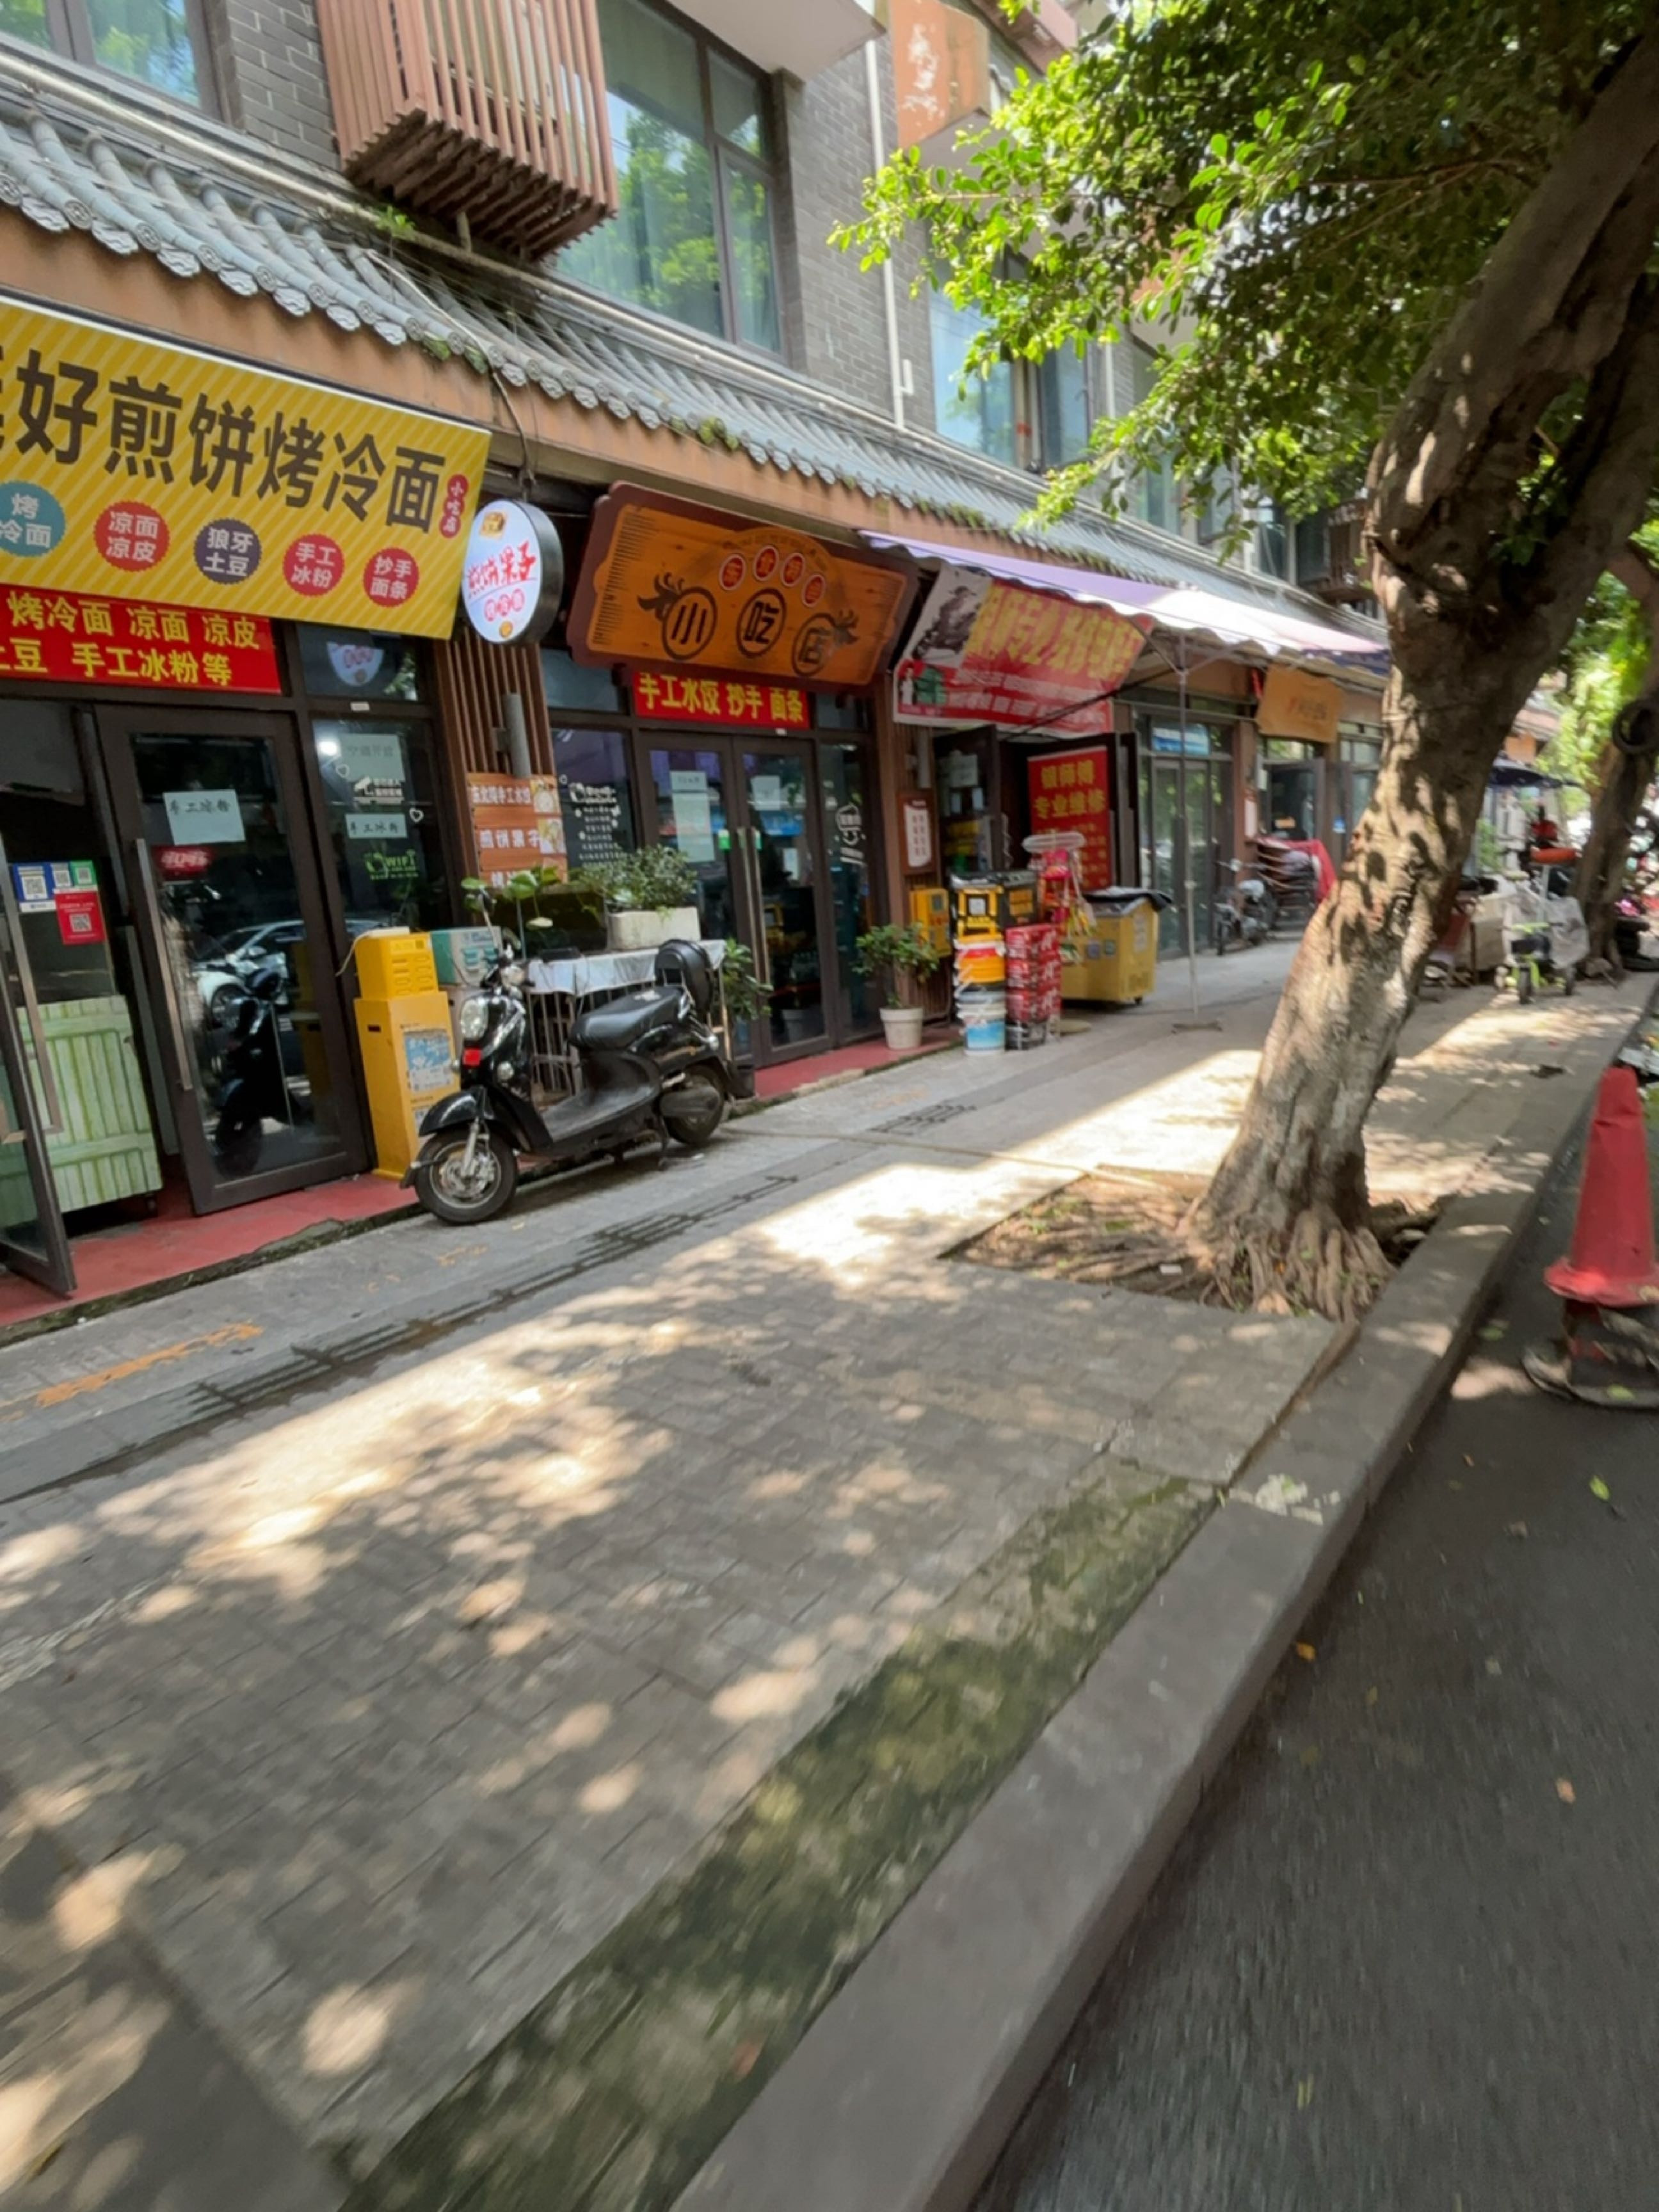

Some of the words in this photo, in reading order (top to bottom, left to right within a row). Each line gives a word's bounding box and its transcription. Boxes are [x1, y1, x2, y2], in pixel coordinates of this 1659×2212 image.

[0, 346, 446, 534] 好煎饼烤冷面
[12, 493, 39, 520] 烤
[443, 480, 465, 533] 小吃店
[0, 519, 51, 548] 冷面
[108, 511, 160, 540] 凉面
[106, 536, 157, 563] 凉皮
[207, 527, 253, 553] 狼牙
[203, 554, 250, 577] 土豆
[296, 542, 337, 567] 手工
[374, 555, 412, 578] 抄手
[291, 565, 333, 588] 冰粉
[369, 577, 408, 600] 面条
[7, 591, 114, 637] 烤冷面
[127, 605, 190, 643] 凉面
[202, 614, 260, 650] 凉皮
[0, 637, 48, 673] 豆
[72, 642, 232, 687] 手工冰粉等
